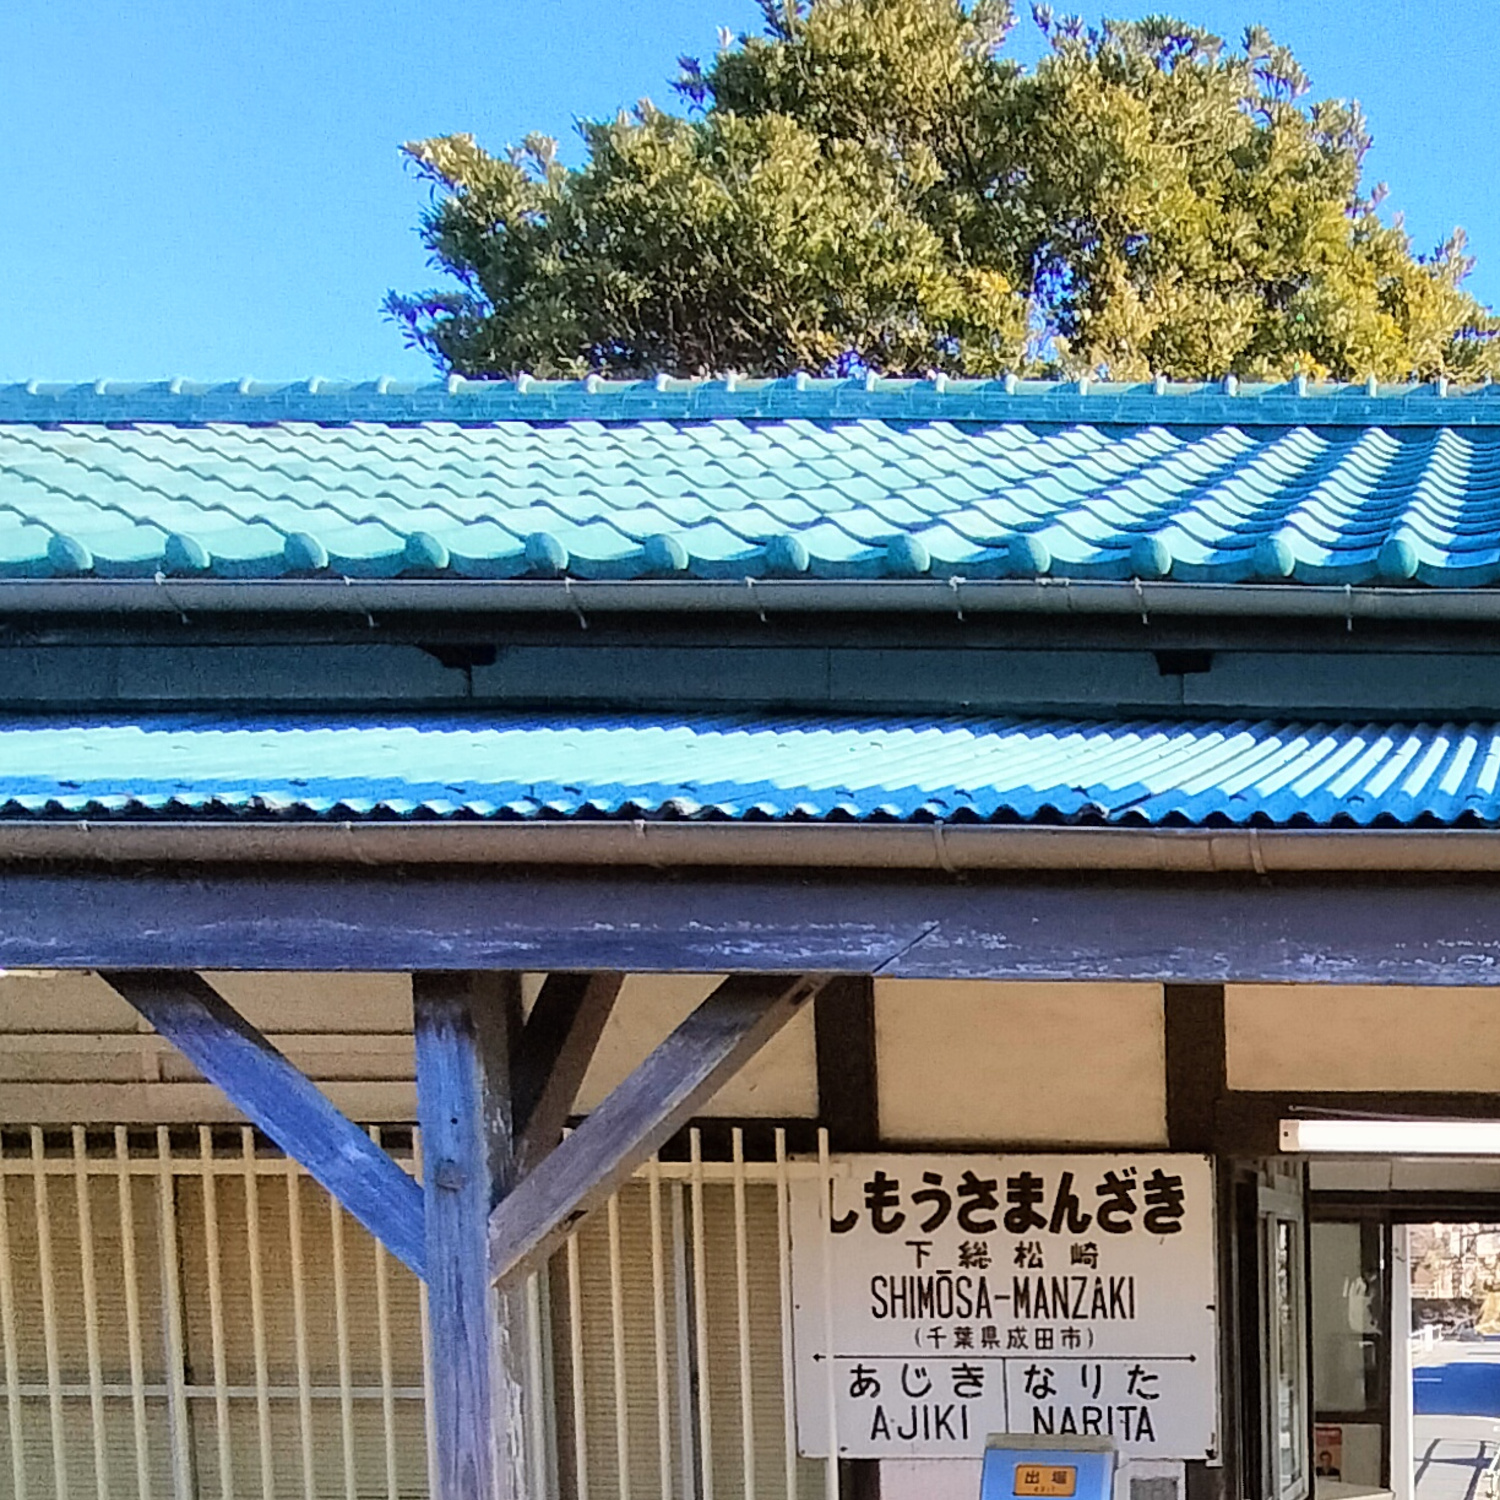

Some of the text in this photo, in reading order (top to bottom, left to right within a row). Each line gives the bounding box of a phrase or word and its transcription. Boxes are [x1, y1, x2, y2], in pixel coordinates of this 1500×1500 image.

[829, 1166, 1185, 1235] しもうさまんざき
[904, 1240, 1100, 1271] 下総松崎
[870, 1269, 1136, 1320] SHIMŌSA-MANZAKI
[848, 1362, 985, 1399] あじき
[1023, 1363, 1160, 1401] なりた
[869, 1404, 969, 1441] AJIKI
[1032, 1405, 1156, 1443] NARITA
